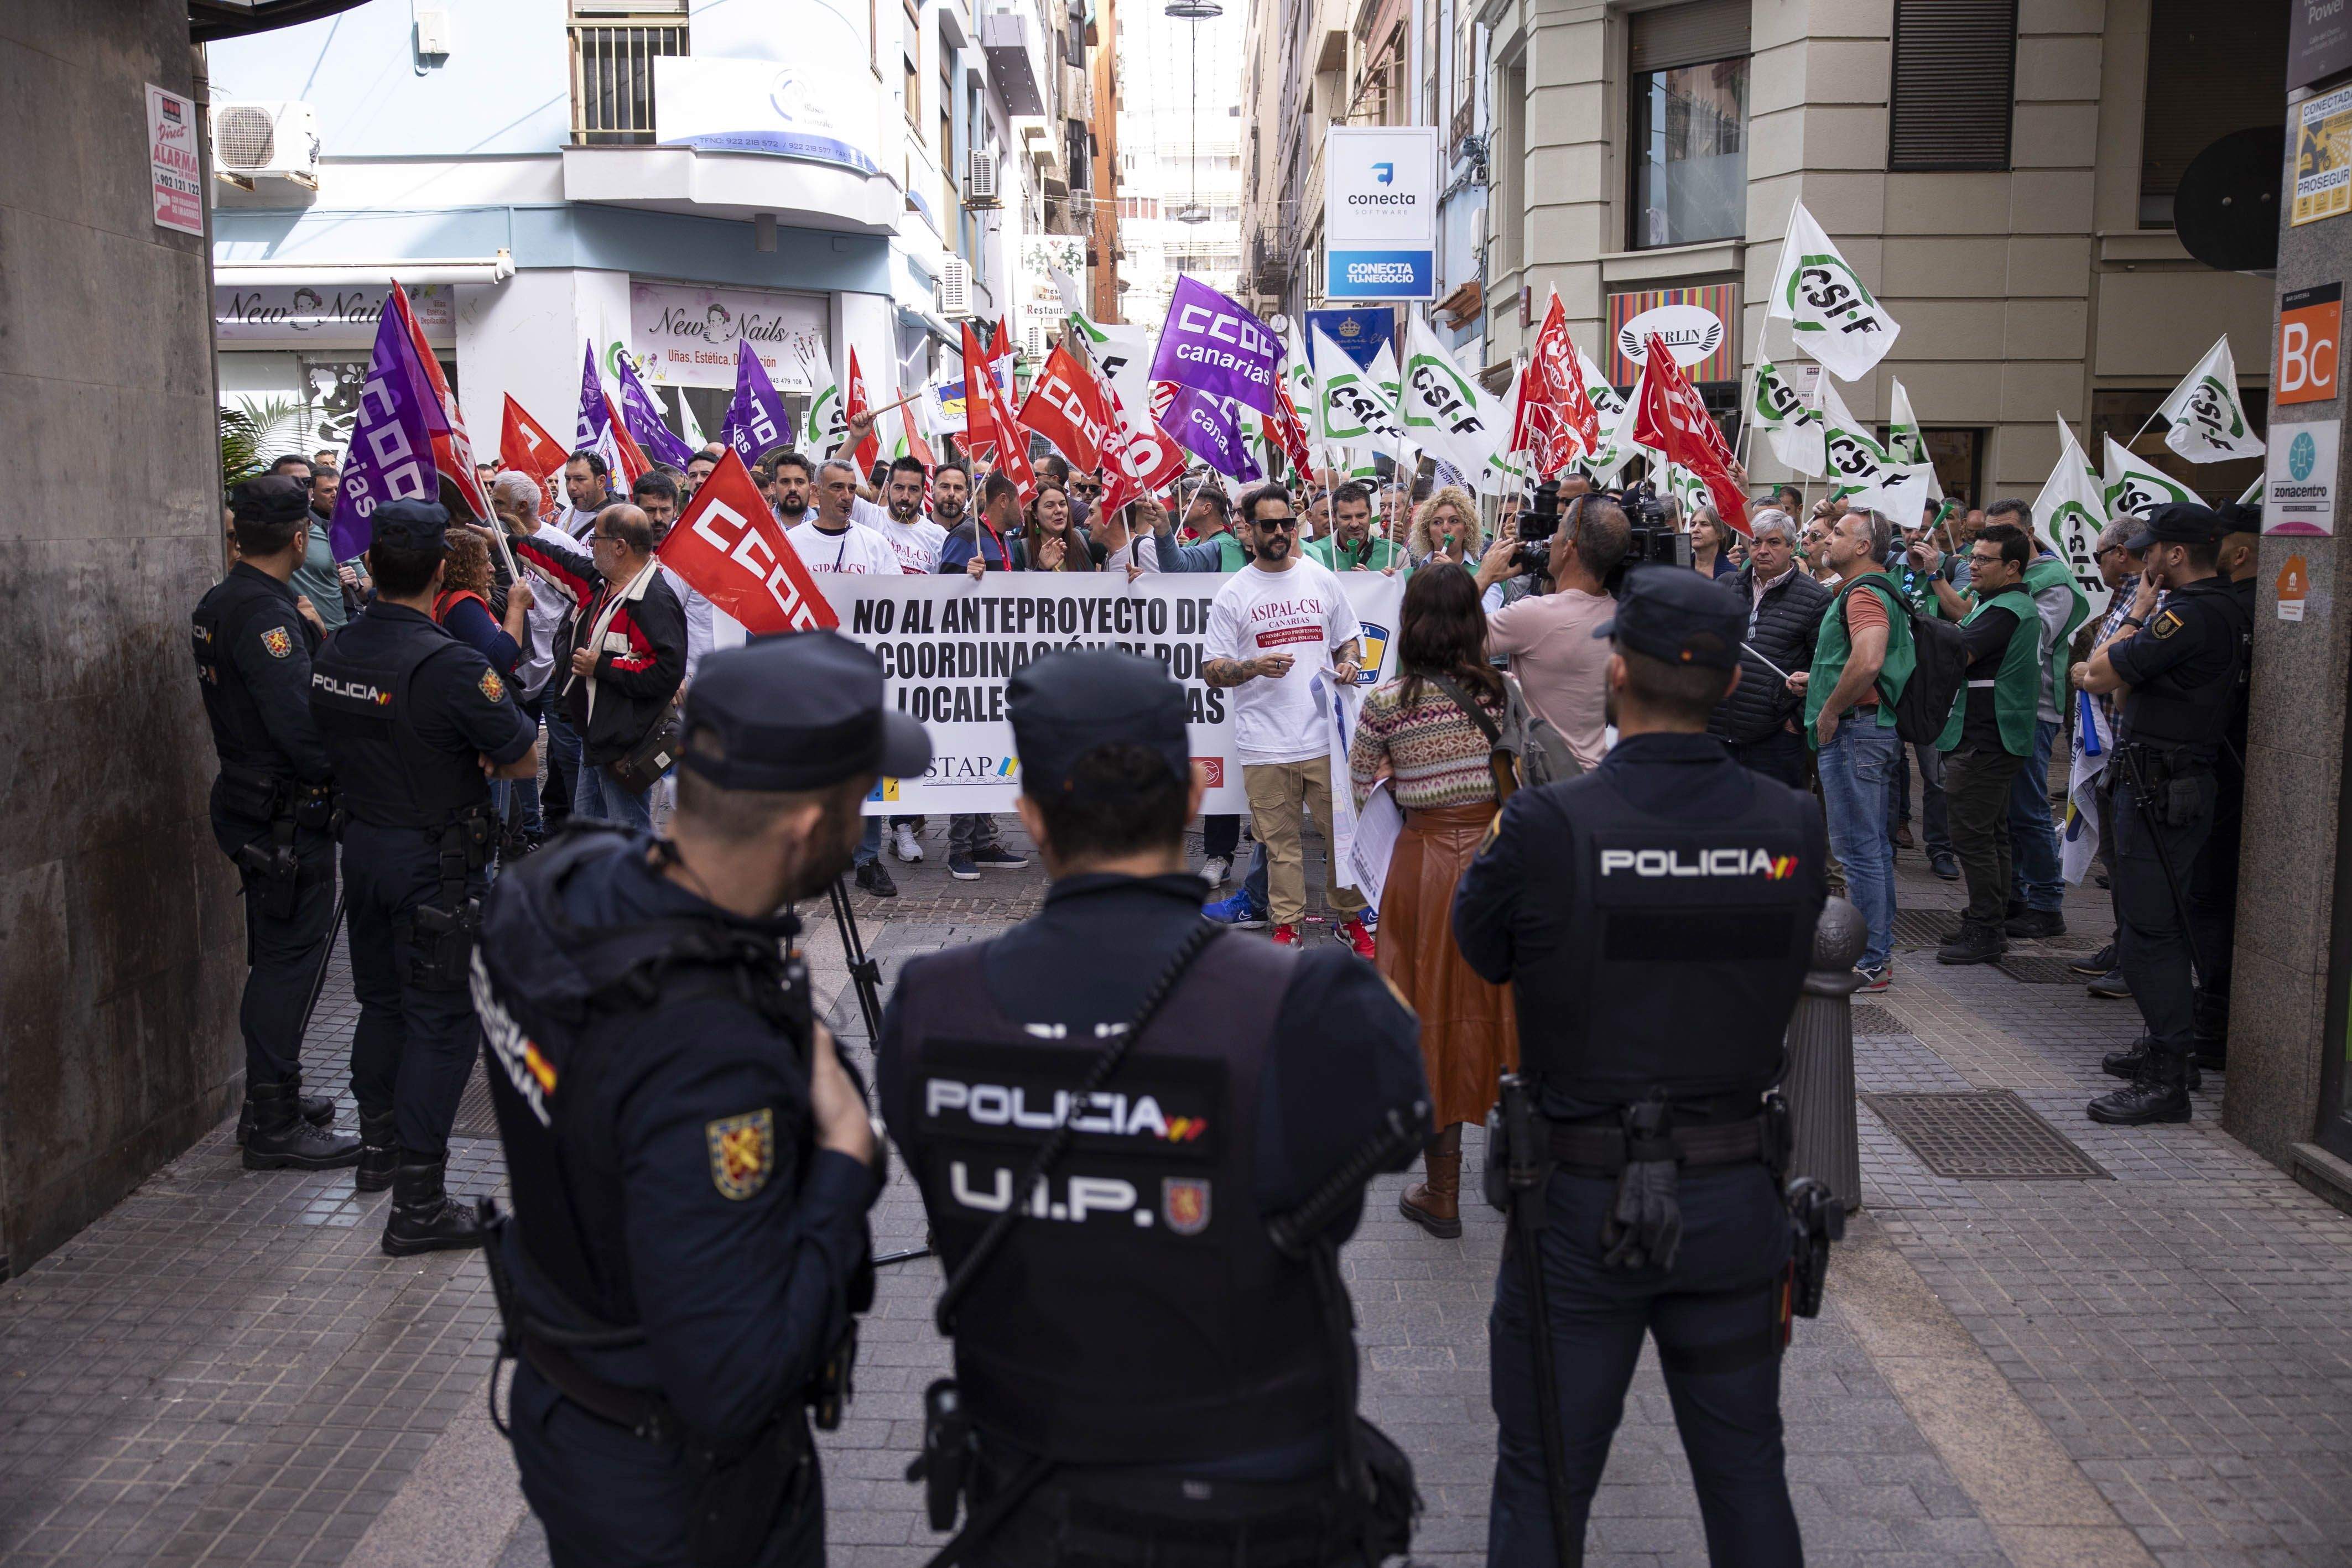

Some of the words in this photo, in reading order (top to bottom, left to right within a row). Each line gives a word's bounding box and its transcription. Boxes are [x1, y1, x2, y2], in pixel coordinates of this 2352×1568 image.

[2308, 0, 2344, 24] Power
[158, 121, 187, 141] Direct
[153, 144, 198, 174] ALARMA
[805, 144, 816, 152] 218
[819, 145, 831, 154] 577
[160, 175, 173, 187] 902
[175, 179, 185, 191] 121
[189, 183, 199, 195] 122
[2298, 169, 2350, 195] PROSEGUR
[1348, 193, 1416, 205] conecta
[1348, 263, 1413, 274] CONECTA
[217, 292, 293, 324] New
[318, 292, 386, 324] Nai
[649, 306, 708, 335] New
[726, 312, 789, 342] Nails
[1643, 329, 1700, 344] RLIN
[1177, 343, 1270, 386] canarias
[2281, 322, 2332, 392] Bc
[953, 437, 969, 457] CCOO
[2274, 483, 2327, 497] zonacentro
[692, 497, 819, 633] CCOO
[853, 599, 895, 634] NO
[900, 600, 935, 634] AL
[940, 597, 1168, 634] ANTEPROYECTO
[1251, 598, 1324, 623] ASIPAL-CSL
[1269, 616, 1310, 628] CANARIAS
[1271, 637, 1297, 645] SINDICATO
[312, 673, 379, 702] POLICIA
[898, 686, 1012, 723] LOCALES
[1601, 848, 1776, 877] POLICIA
[927, 1077, 1168, 1137] POLICIA
[950, 1161, 1154, 1227] UI.P.
